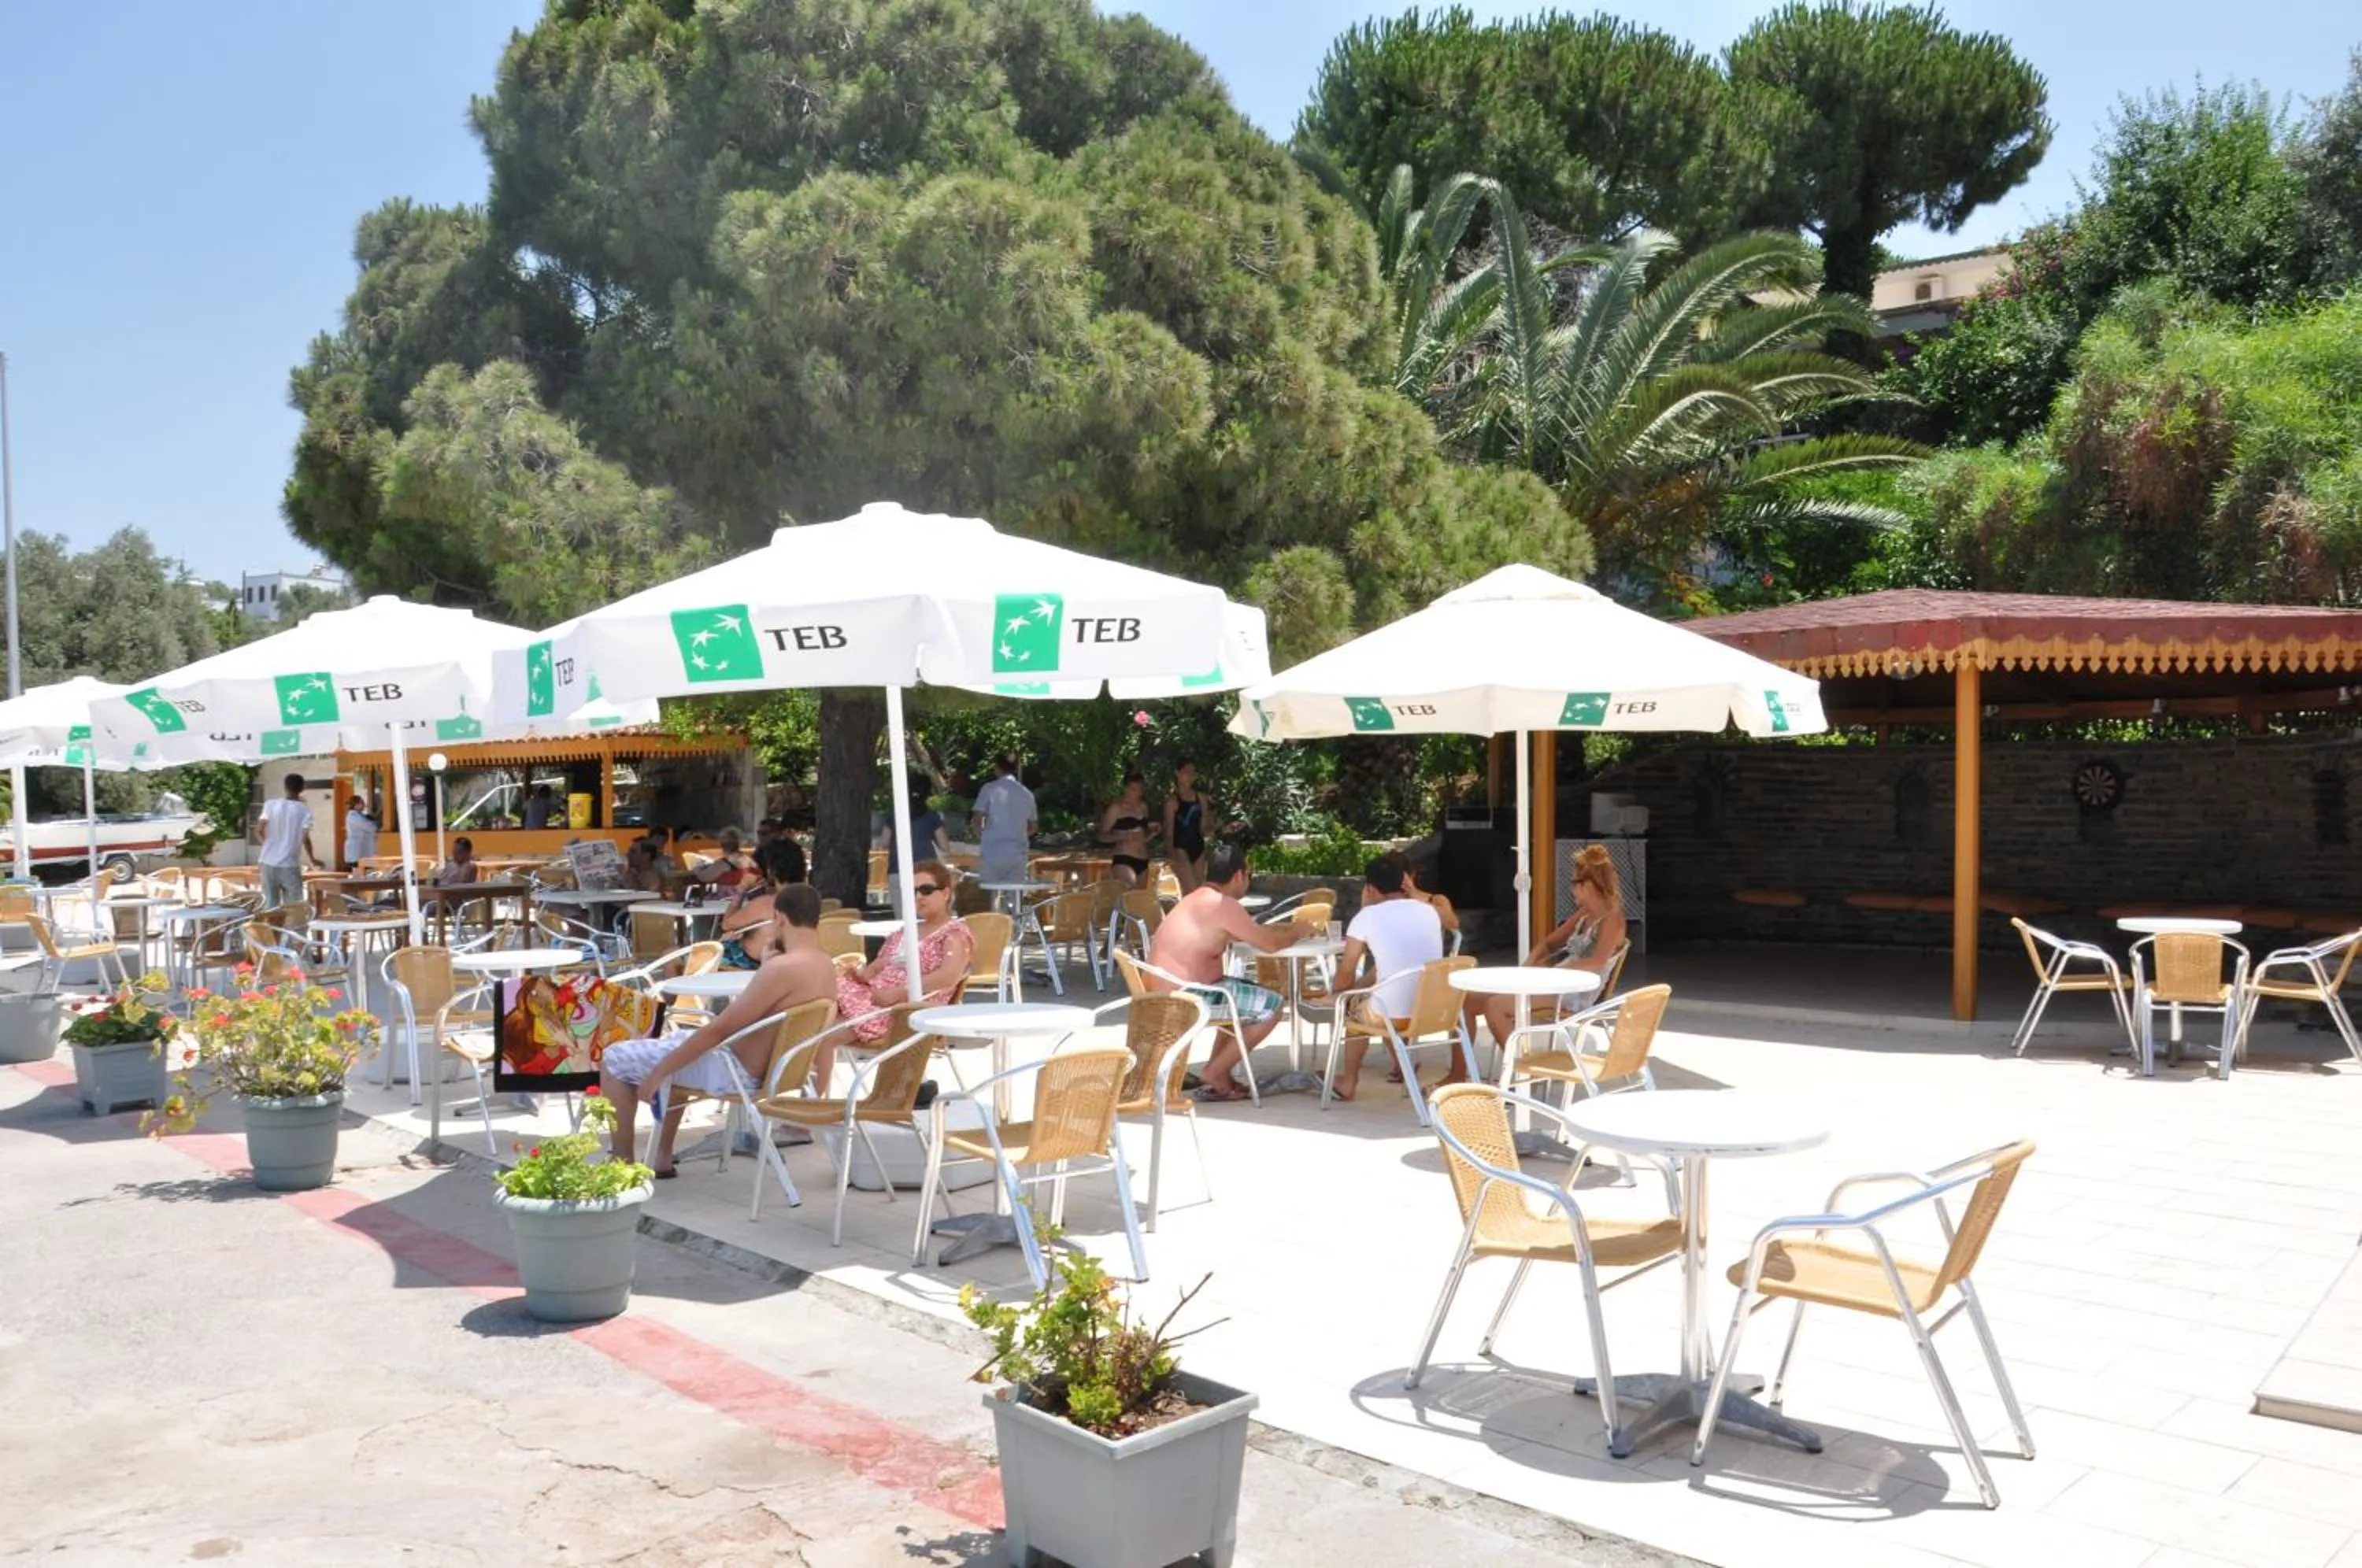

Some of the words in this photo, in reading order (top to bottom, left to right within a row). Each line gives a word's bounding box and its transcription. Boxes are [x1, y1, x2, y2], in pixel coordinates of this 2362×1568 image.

[763, 626, 847, 651] TEB
[1072, 618, 1141, 643] TEB
[554, 657, 574, 688] TEB
[342, 682, 403, 702] TEB
[1391, 704, 1437, 716] TEB
[1614, 701, 1657, 715] TEB
